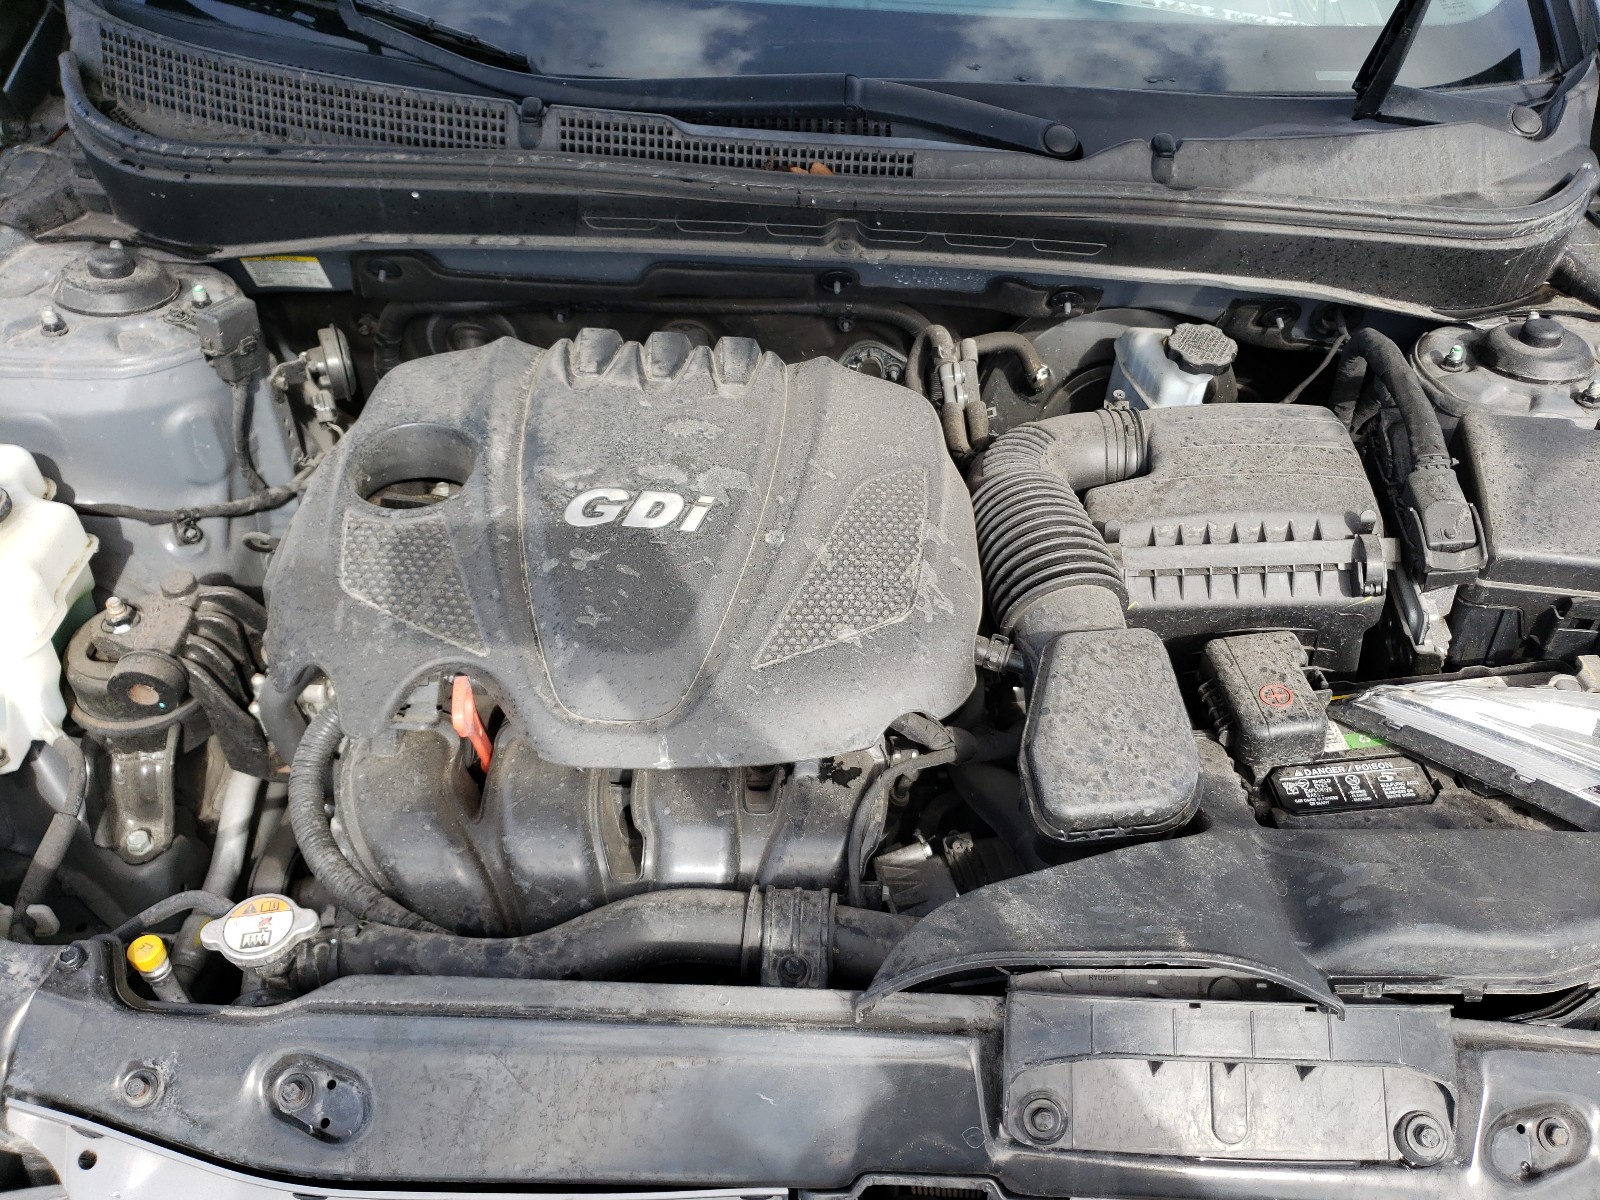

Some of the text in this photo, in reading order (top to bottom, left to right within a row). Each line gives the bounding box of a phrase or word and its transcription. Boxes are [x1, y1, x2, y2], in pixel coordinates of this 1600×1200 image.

[564, 488, 716, 532] GDi
[1304, 766, 1345, 776] DANGER
[1354, 761, 1393, 772] POISON
